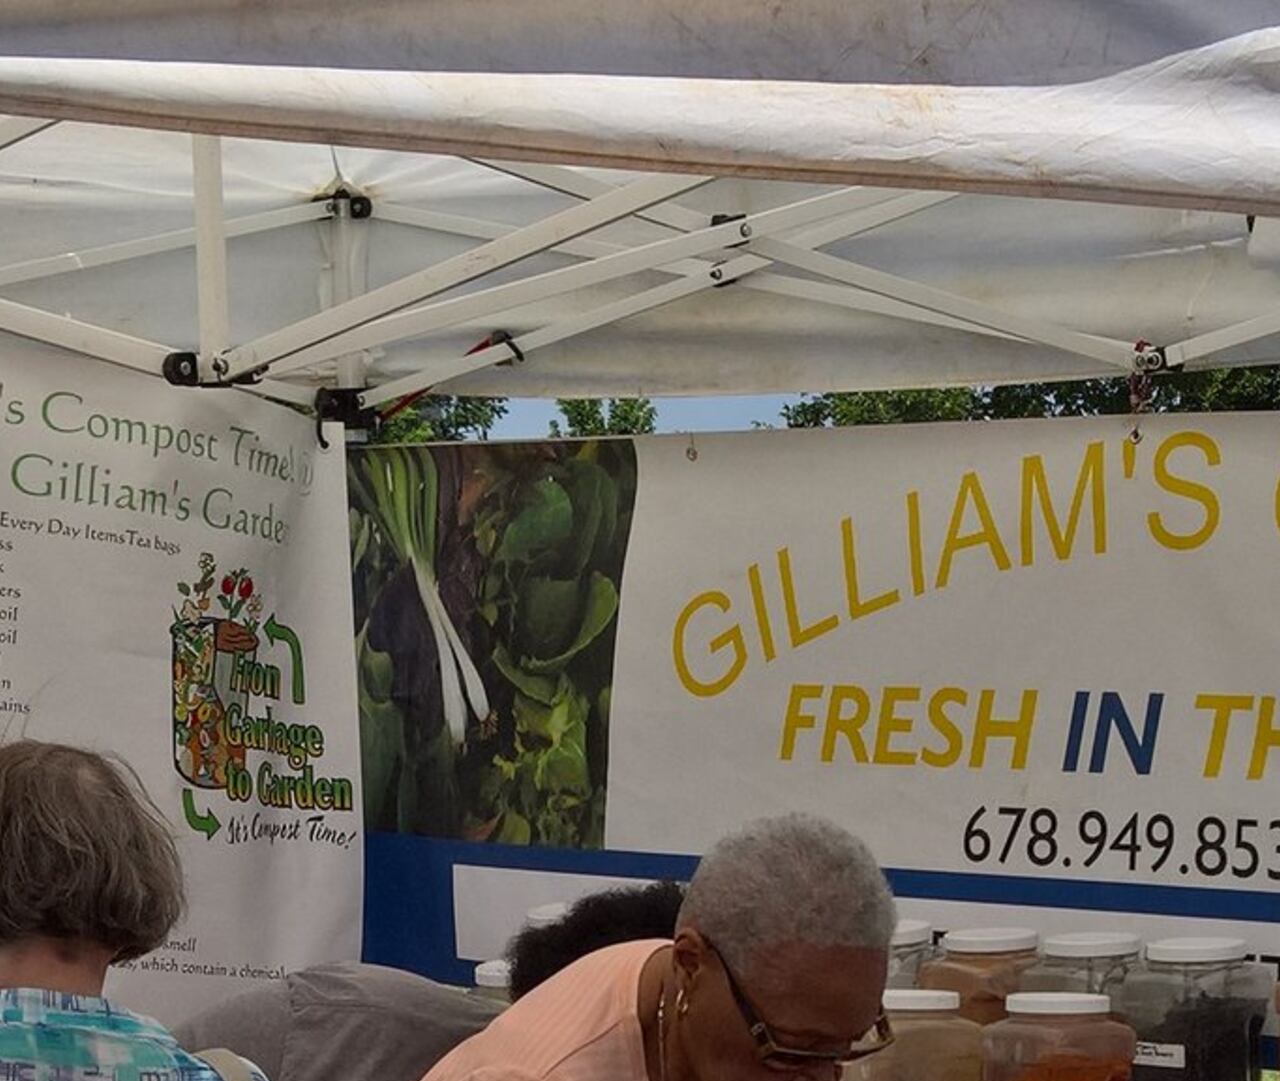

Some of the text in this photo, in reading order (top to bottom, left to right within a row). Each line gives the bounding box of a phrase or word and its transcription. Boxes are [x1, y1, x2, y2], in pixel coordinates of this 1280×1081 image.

[41, 390, 219, 459] Compost
[229, 425, 295, 483] Time!
[0, 511, 44, 535] Every
[47, 518, 82, 540] Day
[153, 534, 182, 556] bags
[10, 452, 288, 544] Gilliam's Garde
[672, 430, 1222, 697] GILLIAM'S
[779, 683, 1038, 771] FRESH
[1061, 690, 1165, 776] IN
[225, 757, 354, 812] to Garden
[306, 814, 358, 850] Time!
[140, 956, 179, 974] which
[181, 961, 228, 977] contain
